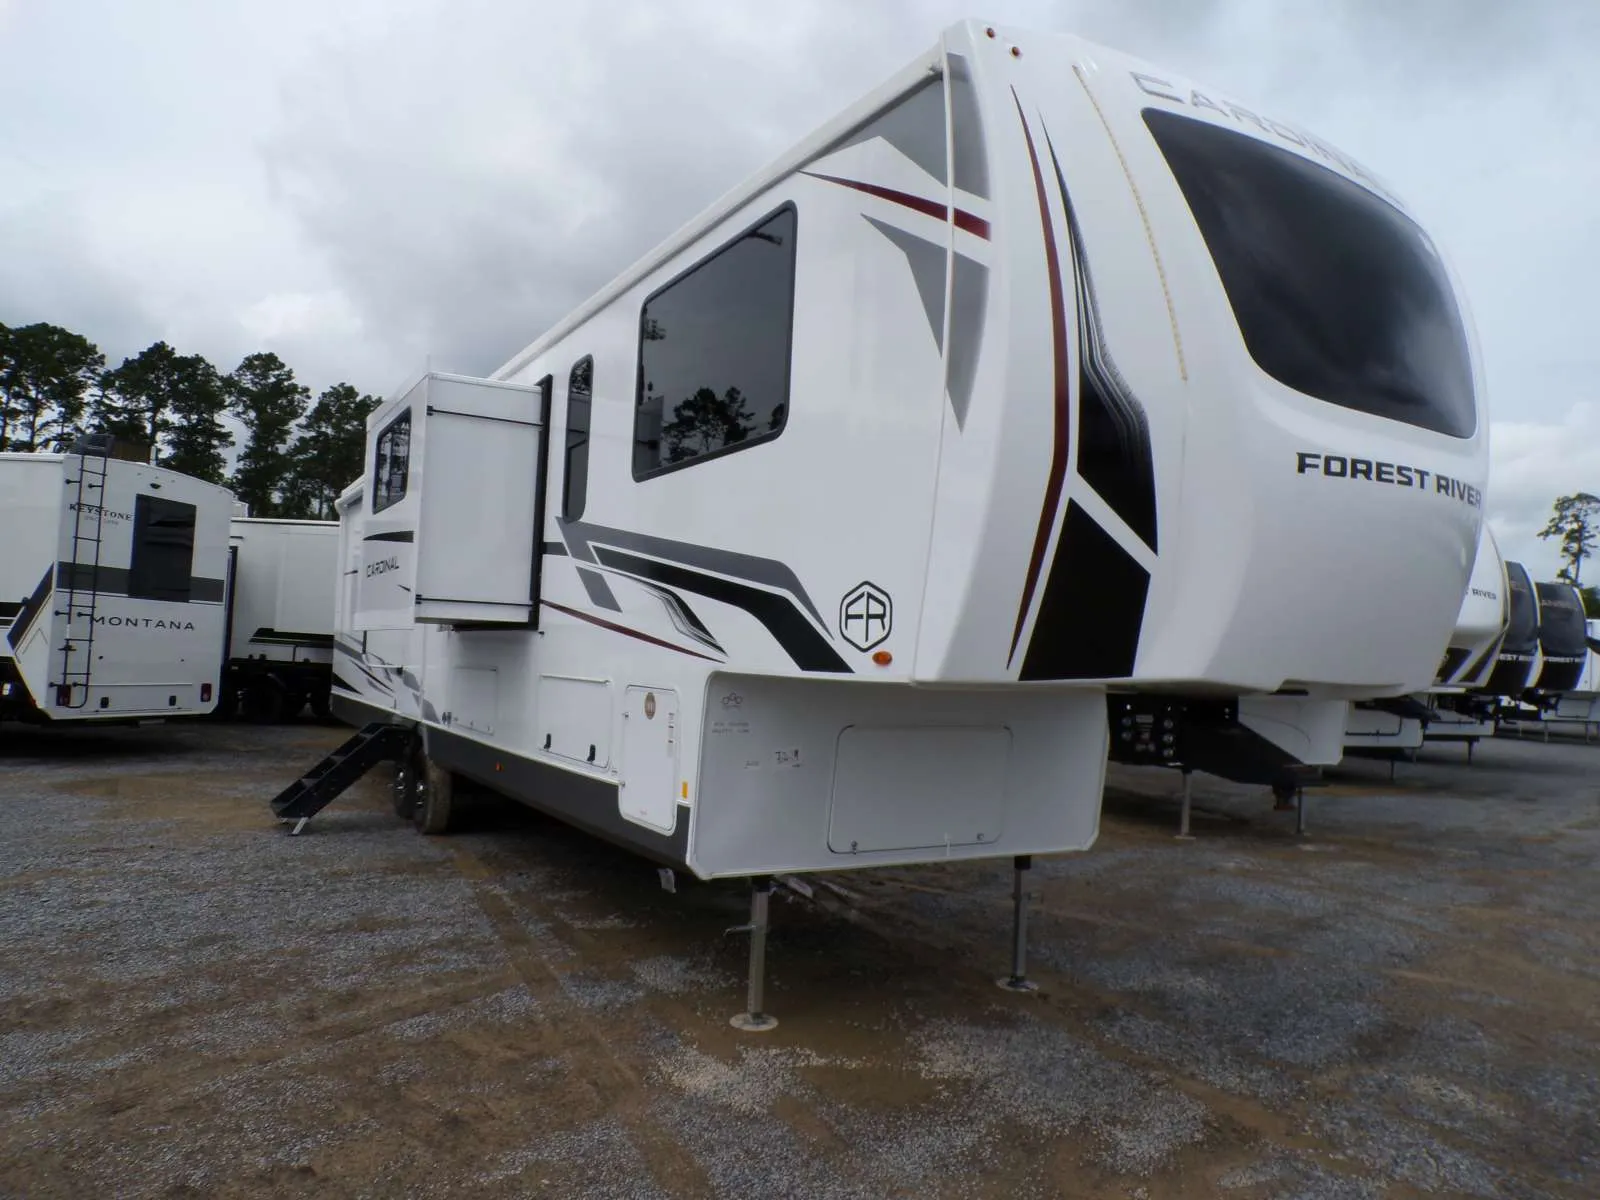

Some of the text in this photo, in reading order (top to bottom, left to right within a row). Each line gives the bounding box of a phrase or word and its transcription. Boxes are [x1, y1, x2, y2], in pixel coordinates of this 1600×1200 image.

[1296, 451, 1482, 511] FOREST RIVER
[69, 502, 133, 522] KEYSTONE
[92, 615, 195, 631] MONTANA
